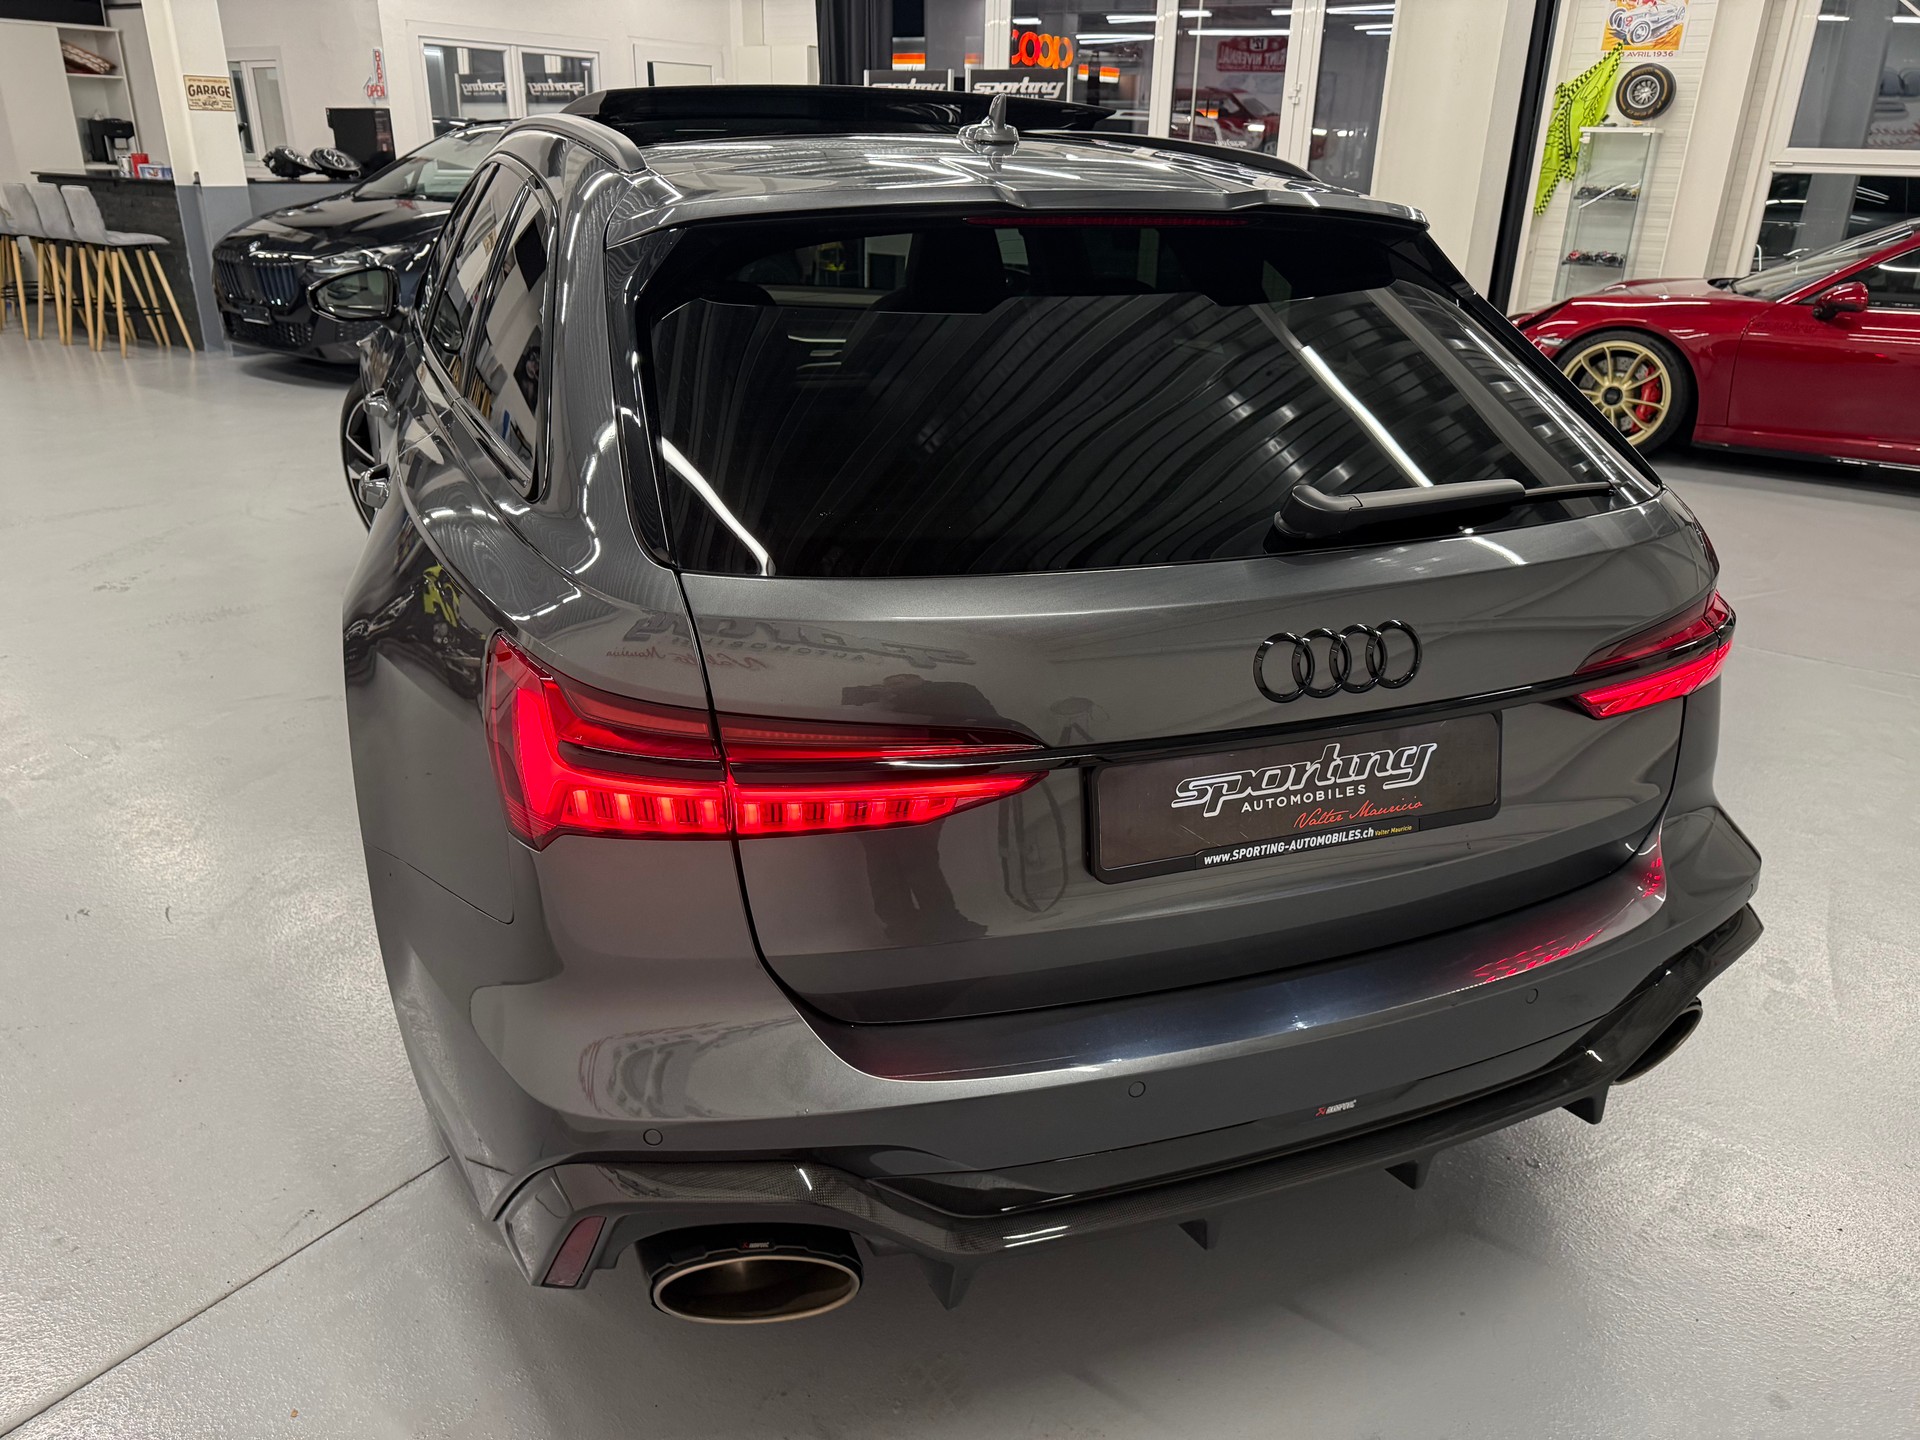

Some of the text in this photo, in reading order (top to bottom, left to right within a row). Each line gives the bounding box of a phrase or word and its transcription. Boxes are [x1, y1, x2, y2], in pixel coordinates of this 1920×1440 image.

[375, 50, 383, 83] BAR
[188, 85, 231, 99] GARAGE
[367, 84, 385, 97] OPEN
[973, 76, 1064, 99] sporting
[1171, 743, 1437, 818] sporting
[1241, 784, 1366, 813] AUTOMOBILES
[1293, 797, 1423, 829] Valter Mauricio
[1204, 825, 1413, 865] www.SPORTING-AUTOMOBILES.ch Valter Mauricio
